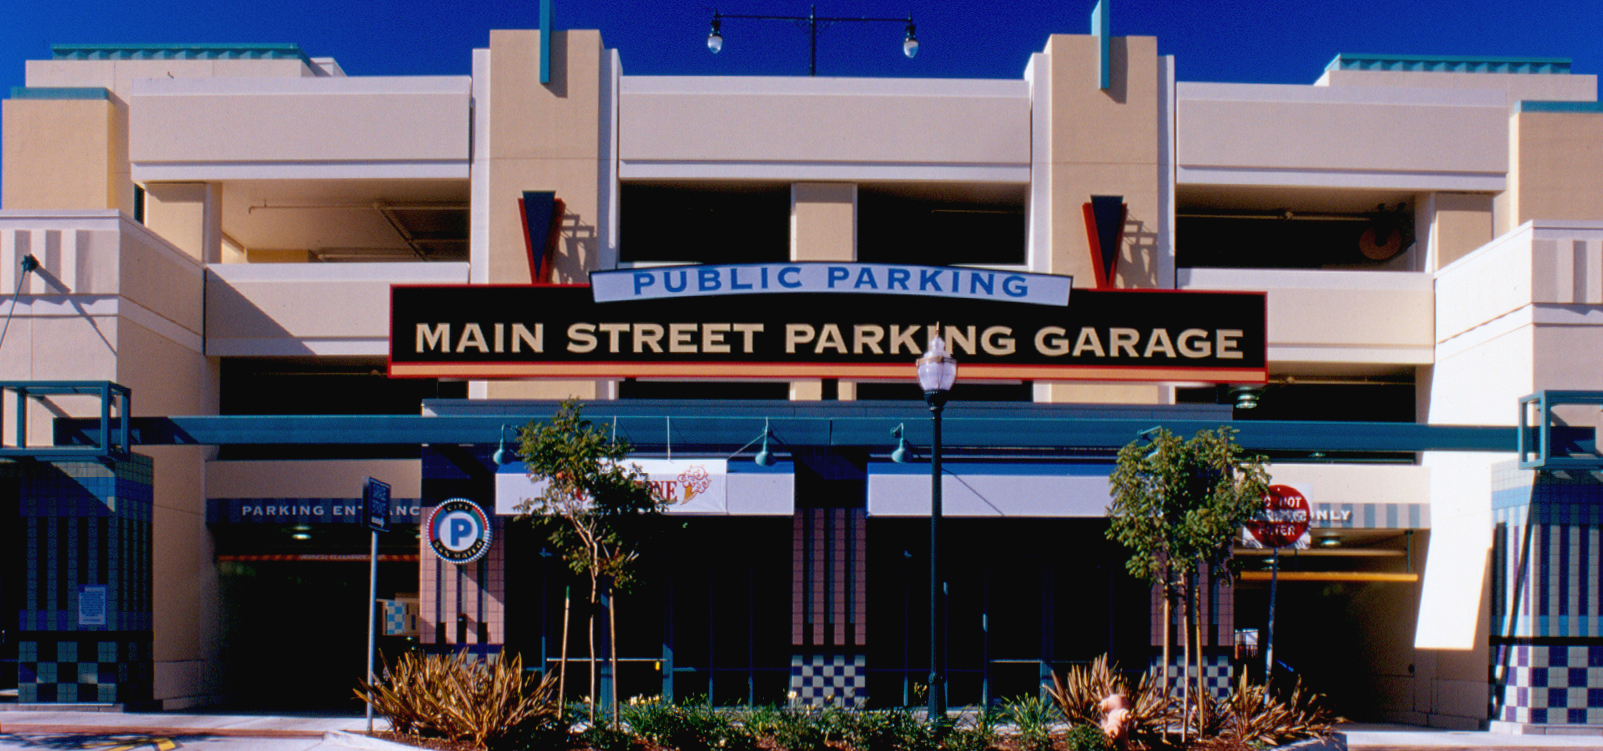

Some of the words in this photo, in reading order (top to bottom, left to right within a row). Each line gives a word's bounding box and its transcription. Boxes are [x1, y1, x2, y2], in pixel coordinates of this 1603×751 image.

[633, 266, 803, 296] PUBLIC
[827, 266, 1029, 298] PARKING
[415, 322, 544, 353] MAIN
[566, 322, 764, 354] STREET
[785, 323, 1016, 356] PARKING
[1034, 326, 1244, 360] GARAGE
[242, 505, 325, 517] PARKING
[1279, 496, 1302, 509] NOT
[1310, 510, 1351, 521] NLY
[450, 518, 473, 547] P
